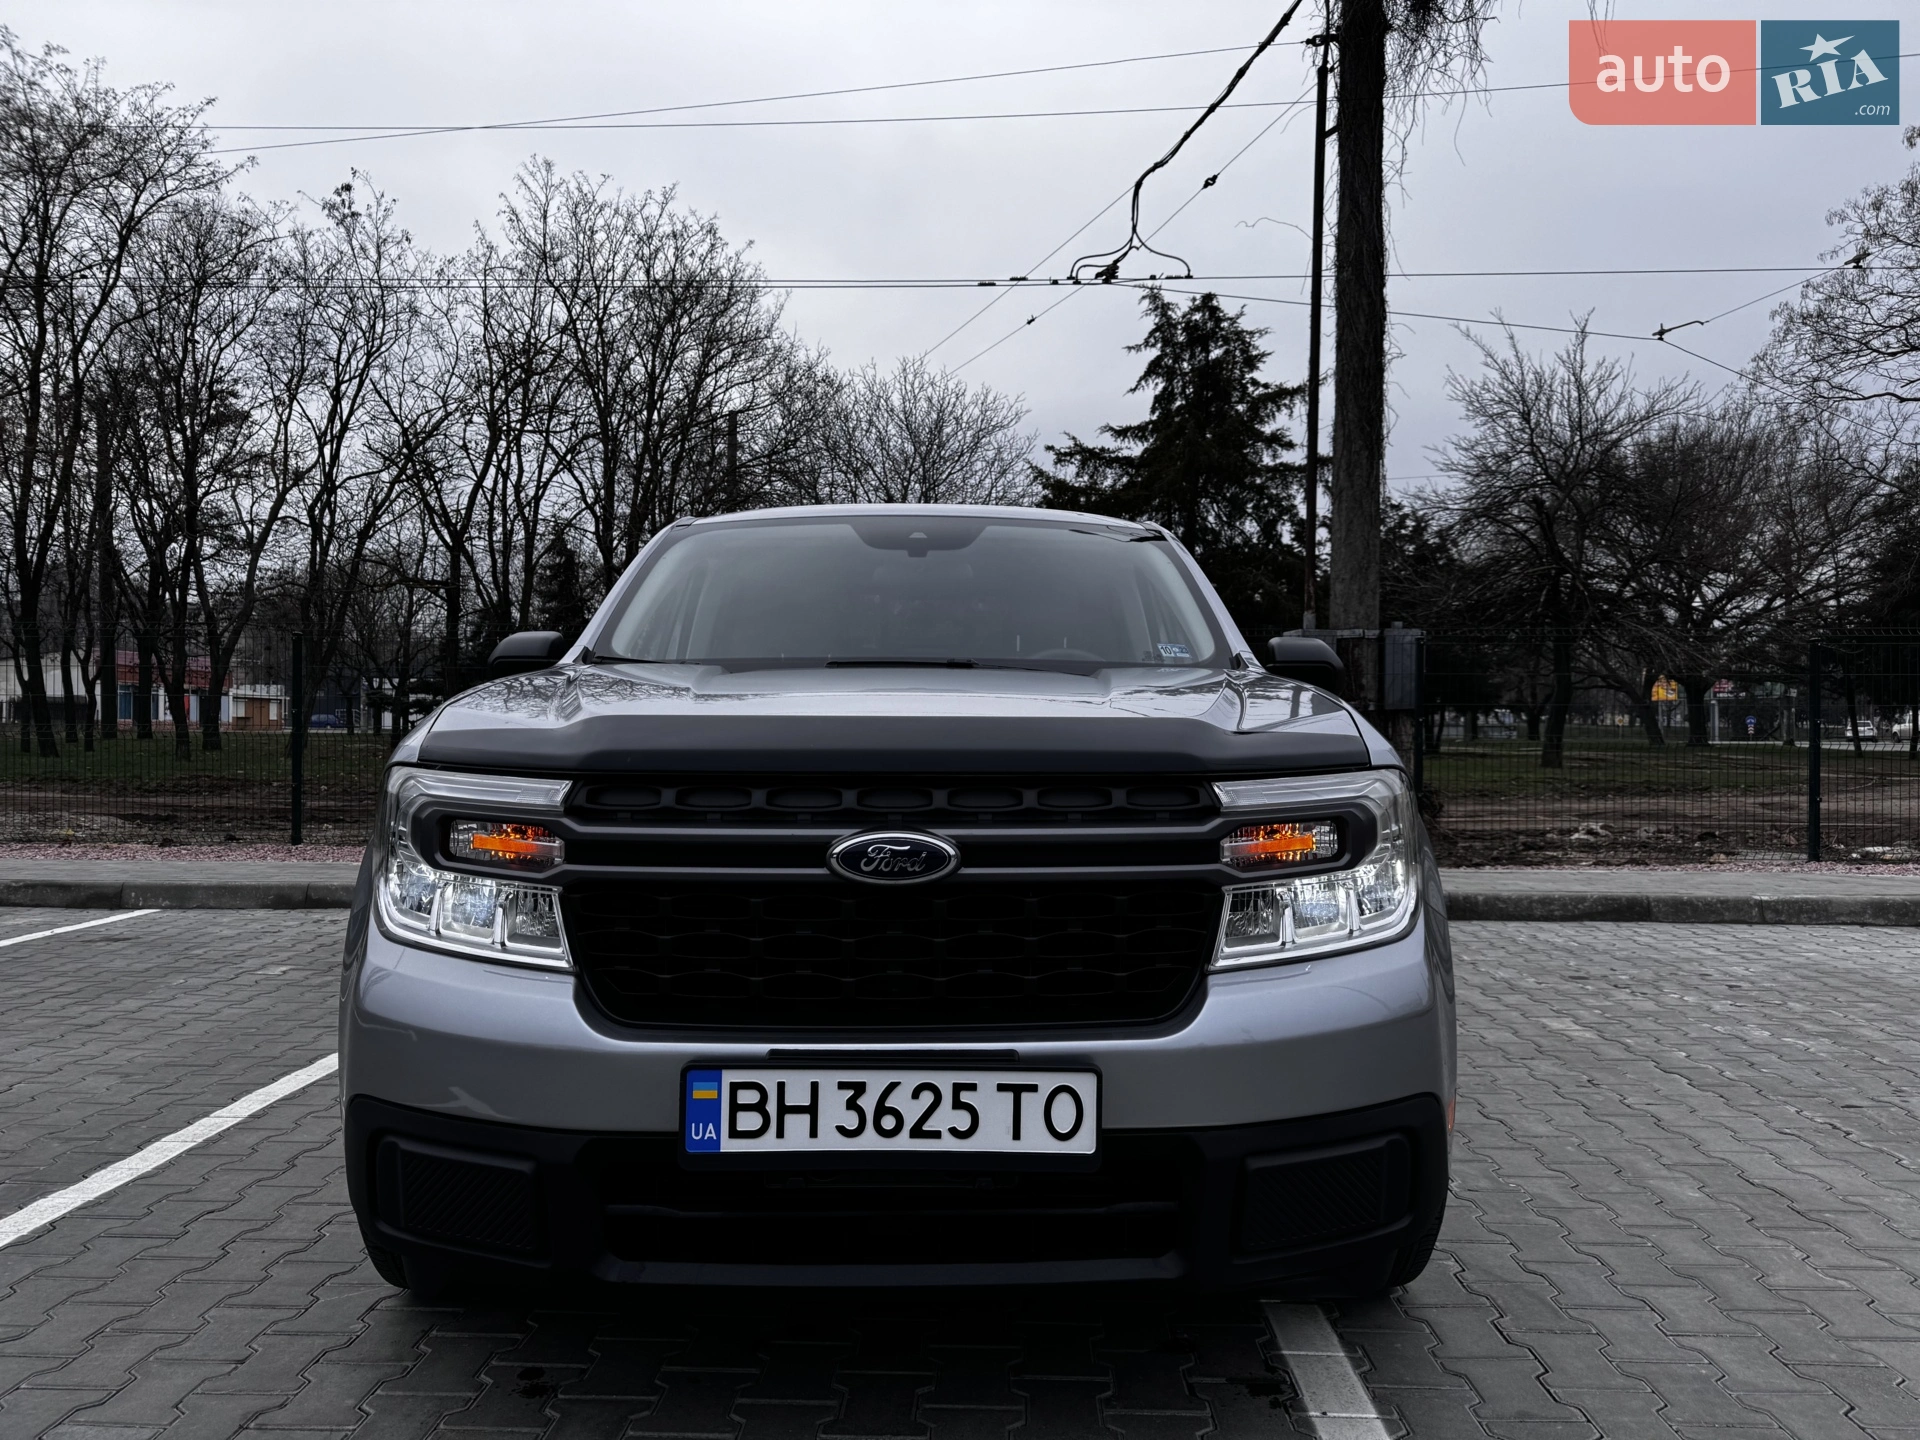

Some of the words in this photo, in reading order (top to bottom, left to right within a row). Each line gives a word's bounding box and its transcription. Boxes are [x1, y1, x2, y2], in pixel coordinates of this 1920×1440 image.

[860, 844, 927, 872] Ford
[728, 1080, 820, 1139] BH
[834, 1081, 980, 1139] 3625
[996, 1083, 1084, 1141] TO
[691, 1123, 717, 1140] UA
